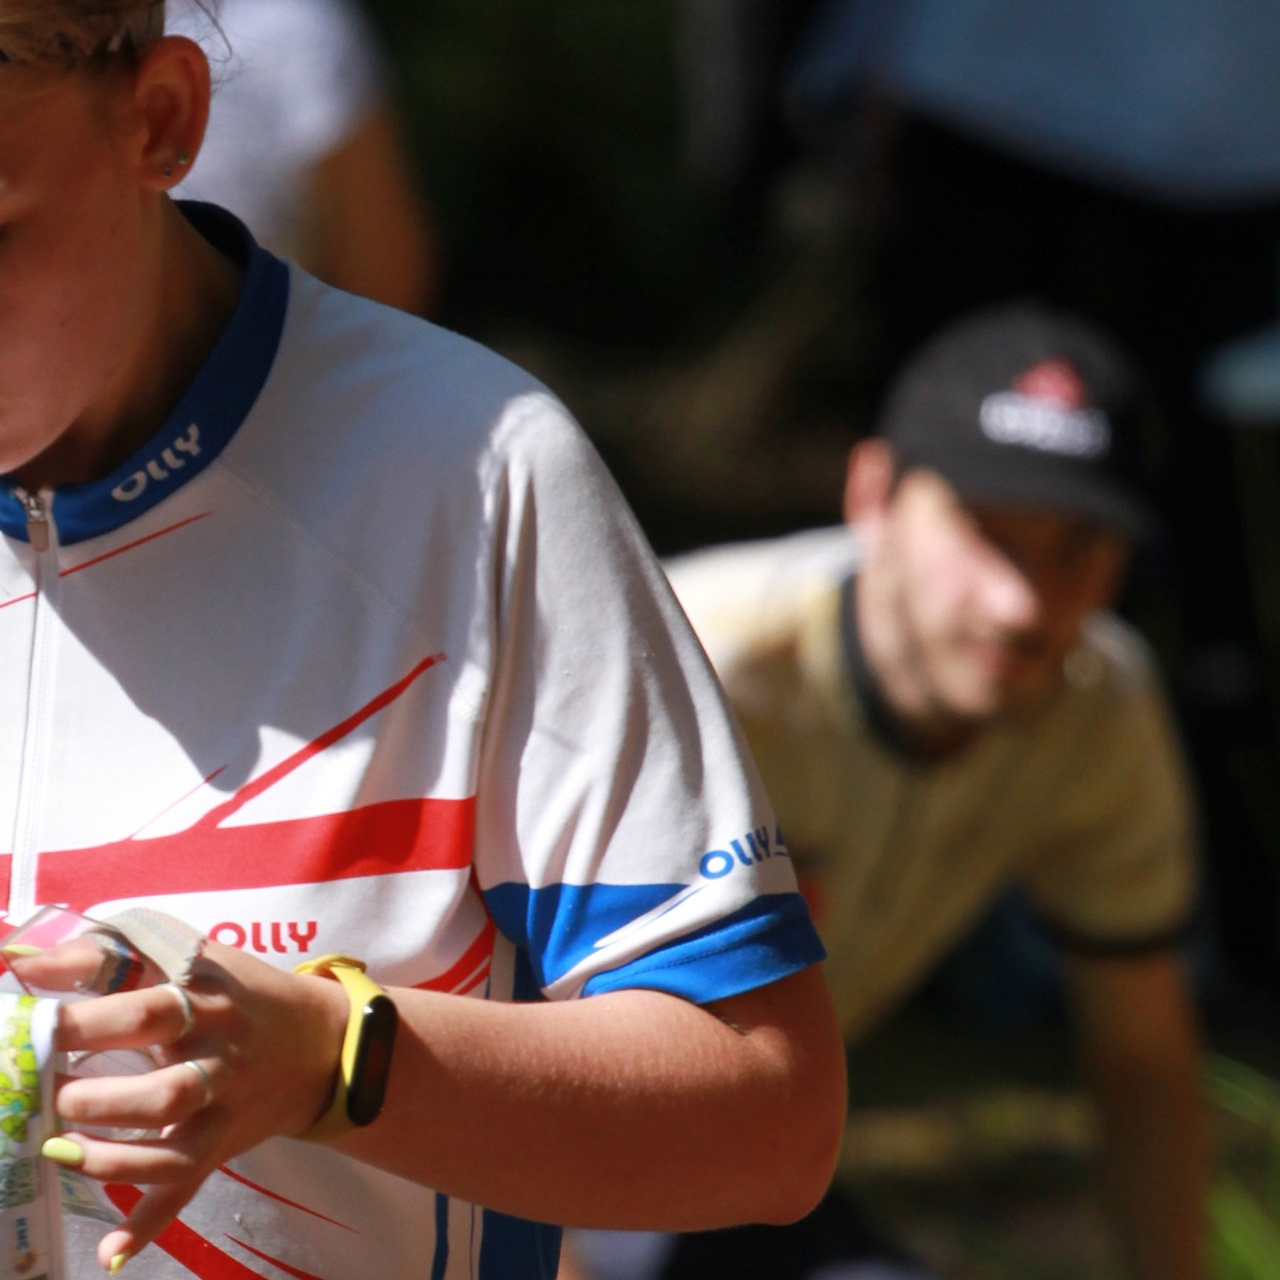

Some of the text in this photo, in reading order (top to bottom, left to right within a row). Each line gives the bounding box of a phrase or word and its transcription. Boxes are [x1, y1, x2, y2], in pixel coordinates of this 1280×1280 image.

[111, 422, 201, 502] OLLY
[699, 825, 772, 879] OLLY
[207, 920, 317, 954] OLLY
